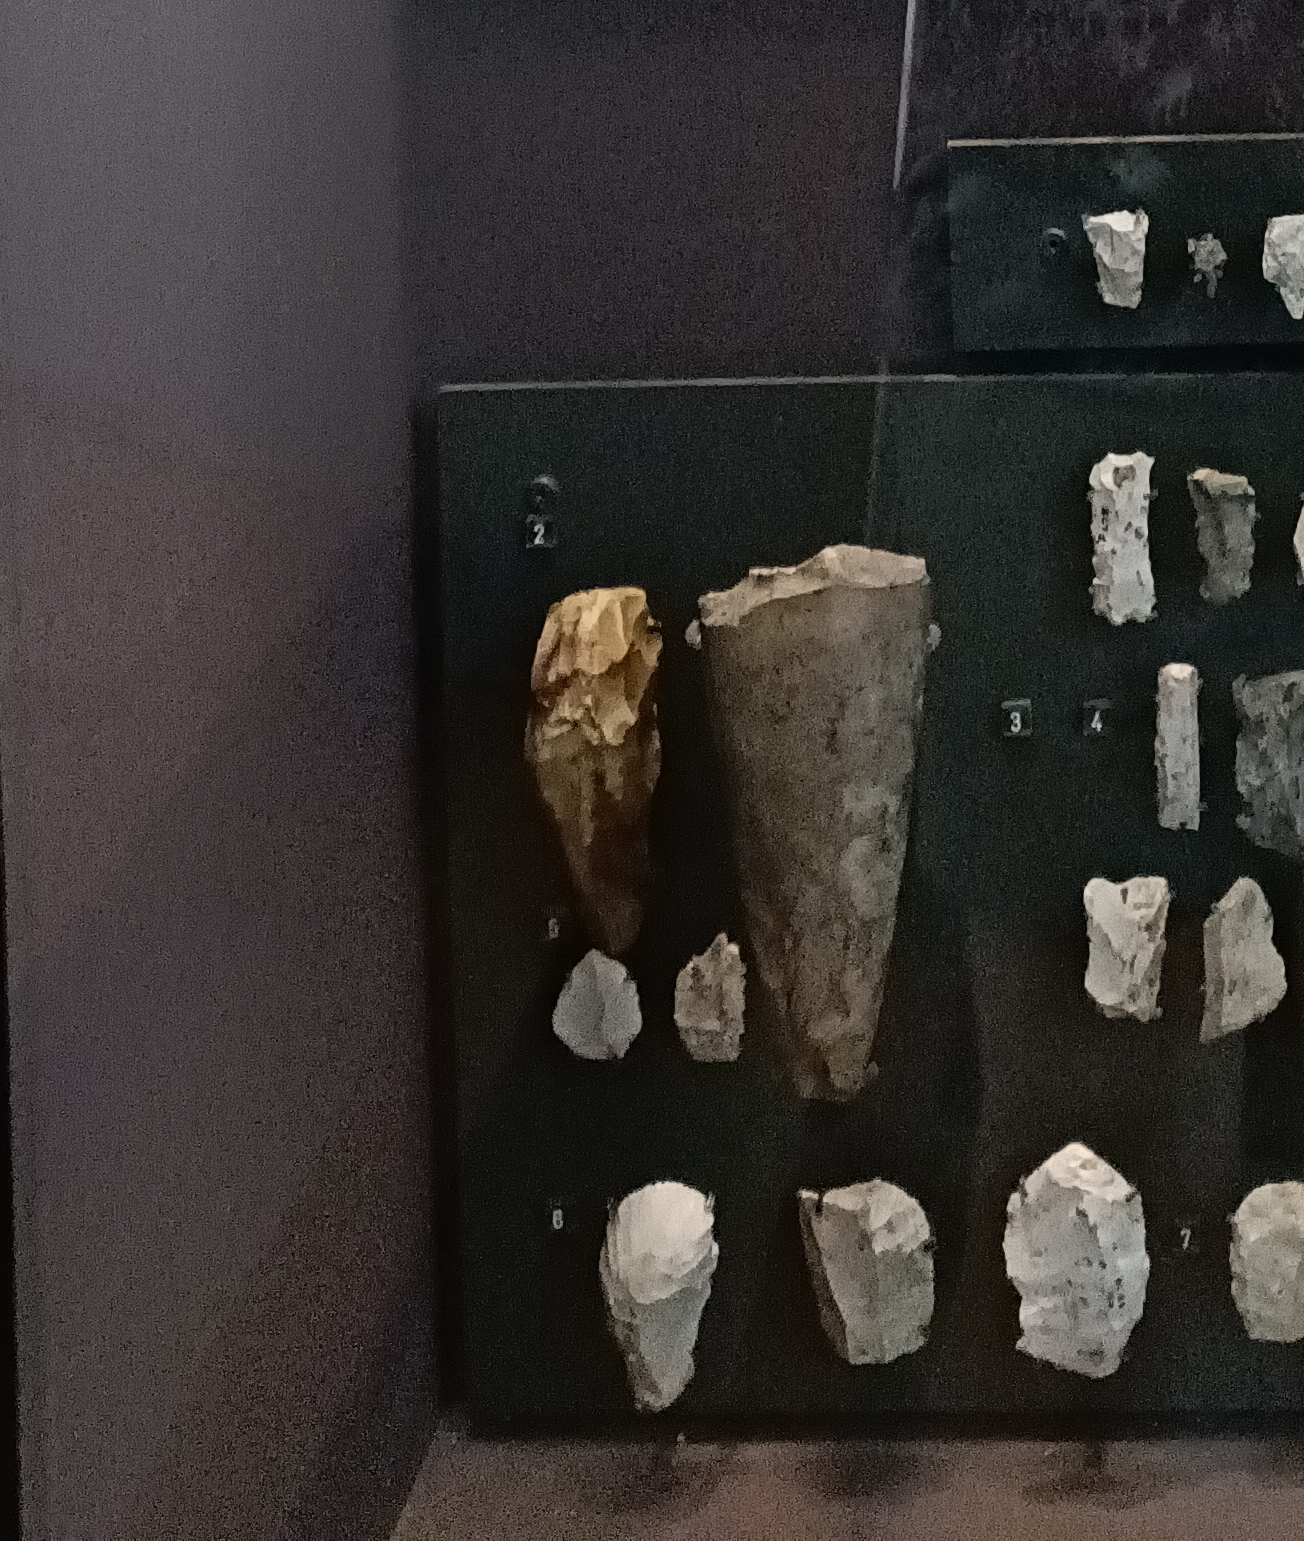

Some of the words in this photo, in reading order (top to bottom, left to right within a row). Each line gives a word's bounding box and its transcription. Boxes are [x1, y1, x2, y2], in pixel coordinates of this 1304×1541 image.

[533, 524, 545, 545] 2
[1010, 712, 1021, 733] 3
[1091, 710, 1102, 732] 4
[1180, 1228, 1191, 1250] 7
